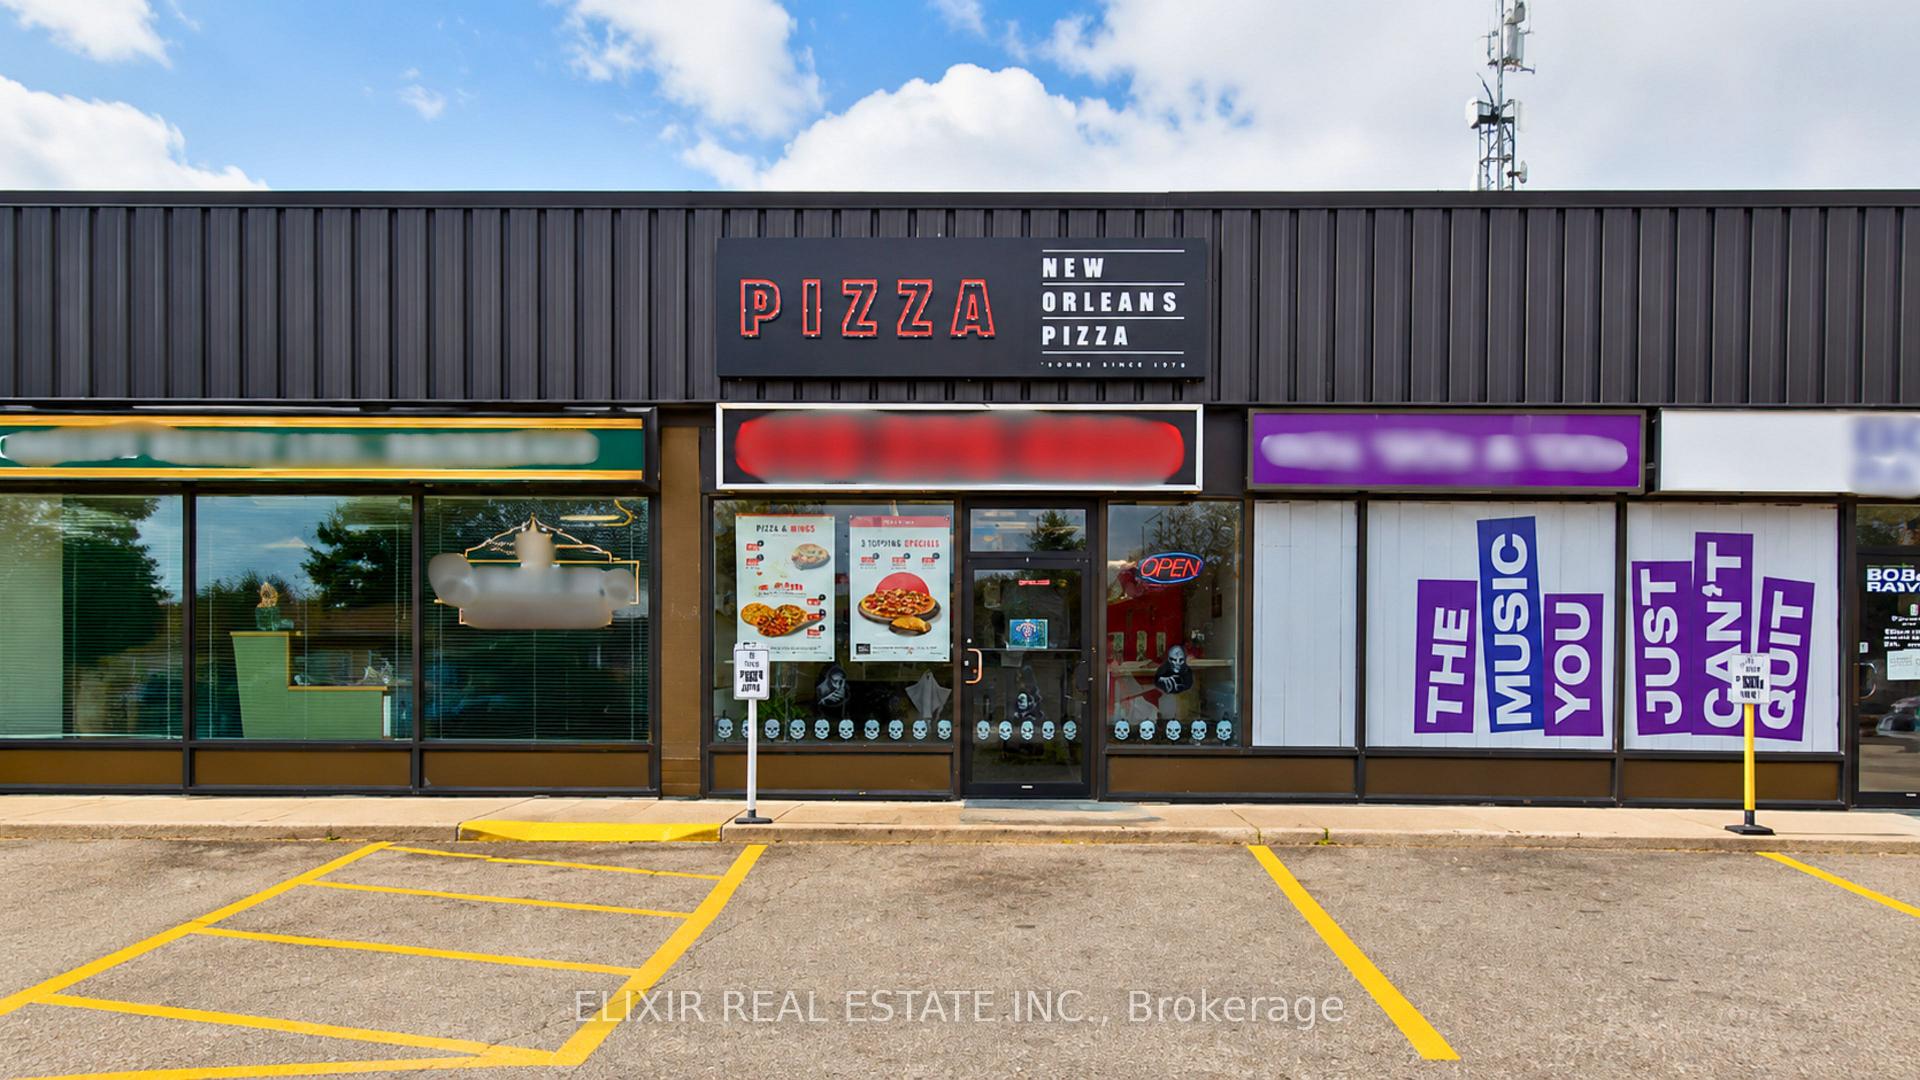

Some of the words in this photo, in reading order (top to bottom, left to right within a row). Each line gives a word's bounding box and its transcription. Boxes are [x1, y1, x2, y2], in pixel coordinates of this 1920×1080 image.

[740, 279, 995, 337] PIZZA
[1042, 257, 1104, 279] NEW
[1042, 291, 1177, 313] ORLEANS
[1042, 325, 1129, 346] PIZZA
[756, 524, 779, 533] PIZZA
[790, 525, 816, 533] WINGS
[1140, 558, 1201, 578] OPEN
[1426, 607, 1470, 724] THE
[1490, 533, 1532, 725] MUSIC
[1553, 602, 1591, 725] YOU
[1640, 569, 1683, 725] JUST
[1702, 541, 1742, 728] CAN'T
[1759, 590, 1804, 730] QUIT
